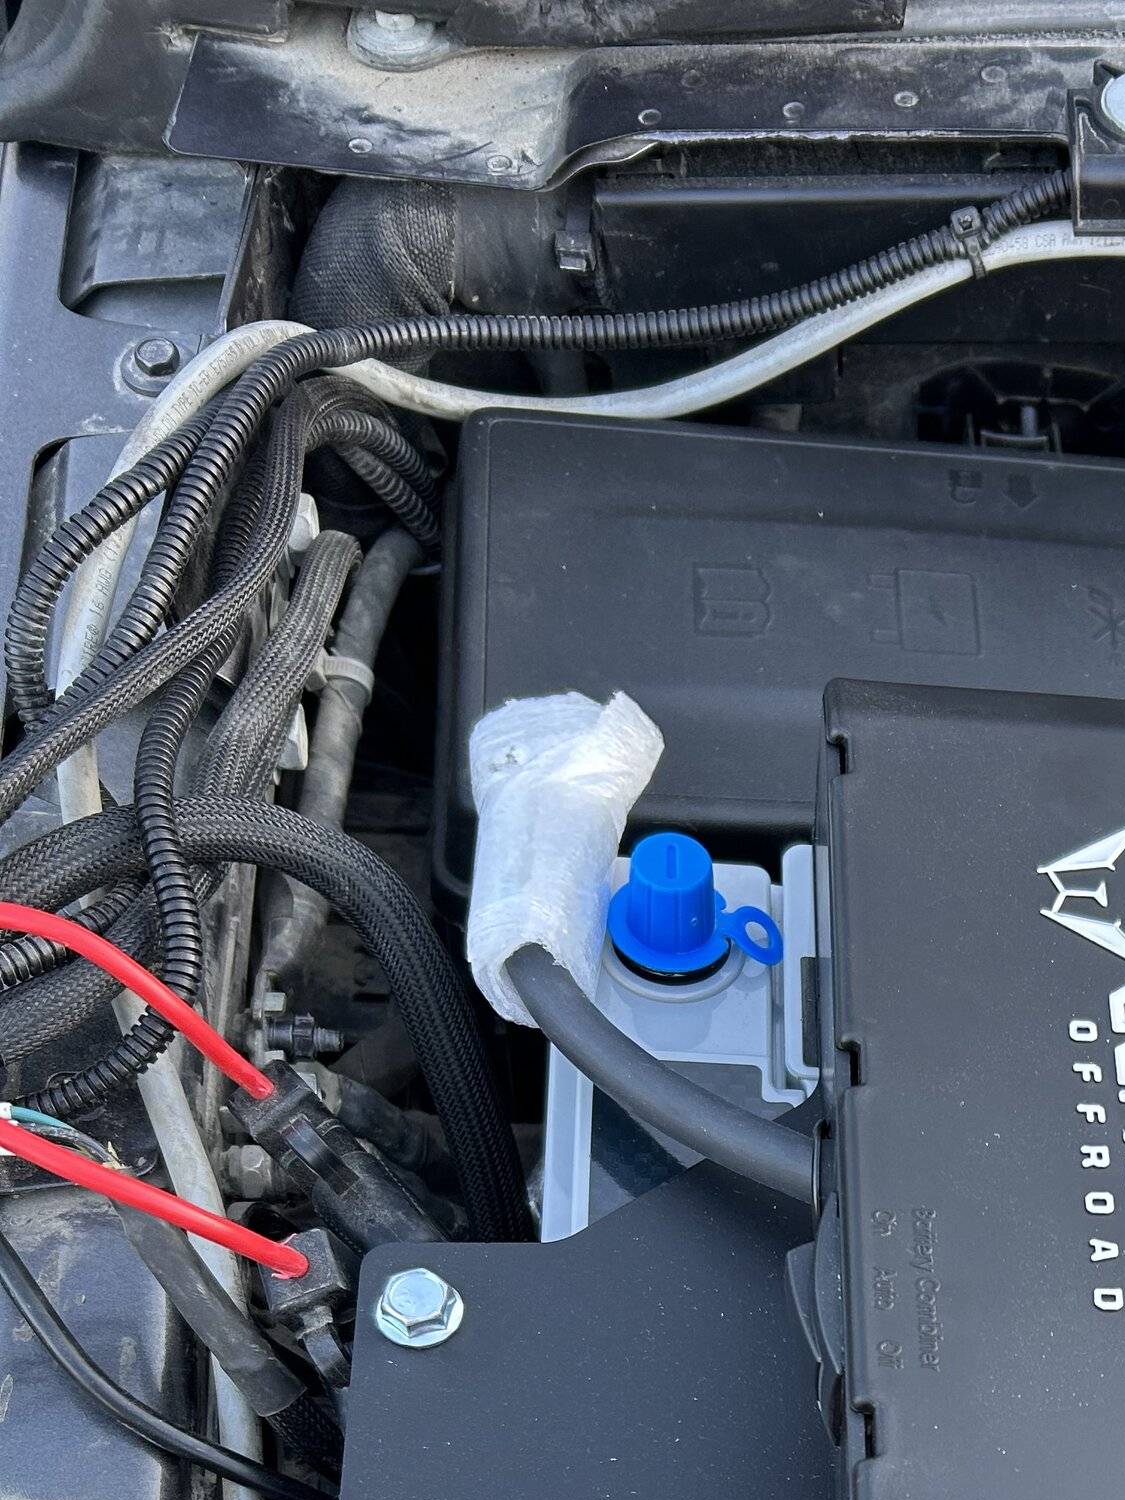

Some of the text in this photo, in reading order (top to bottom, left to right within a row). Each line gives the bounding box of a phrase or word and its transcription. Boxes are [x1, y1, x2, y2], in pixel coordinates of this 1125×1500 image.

[872, 1266, 899, 1311] Auto
[909, 1205, 945, 1373] Battery Combiner
[876, 1339, 905, 1369] Off
